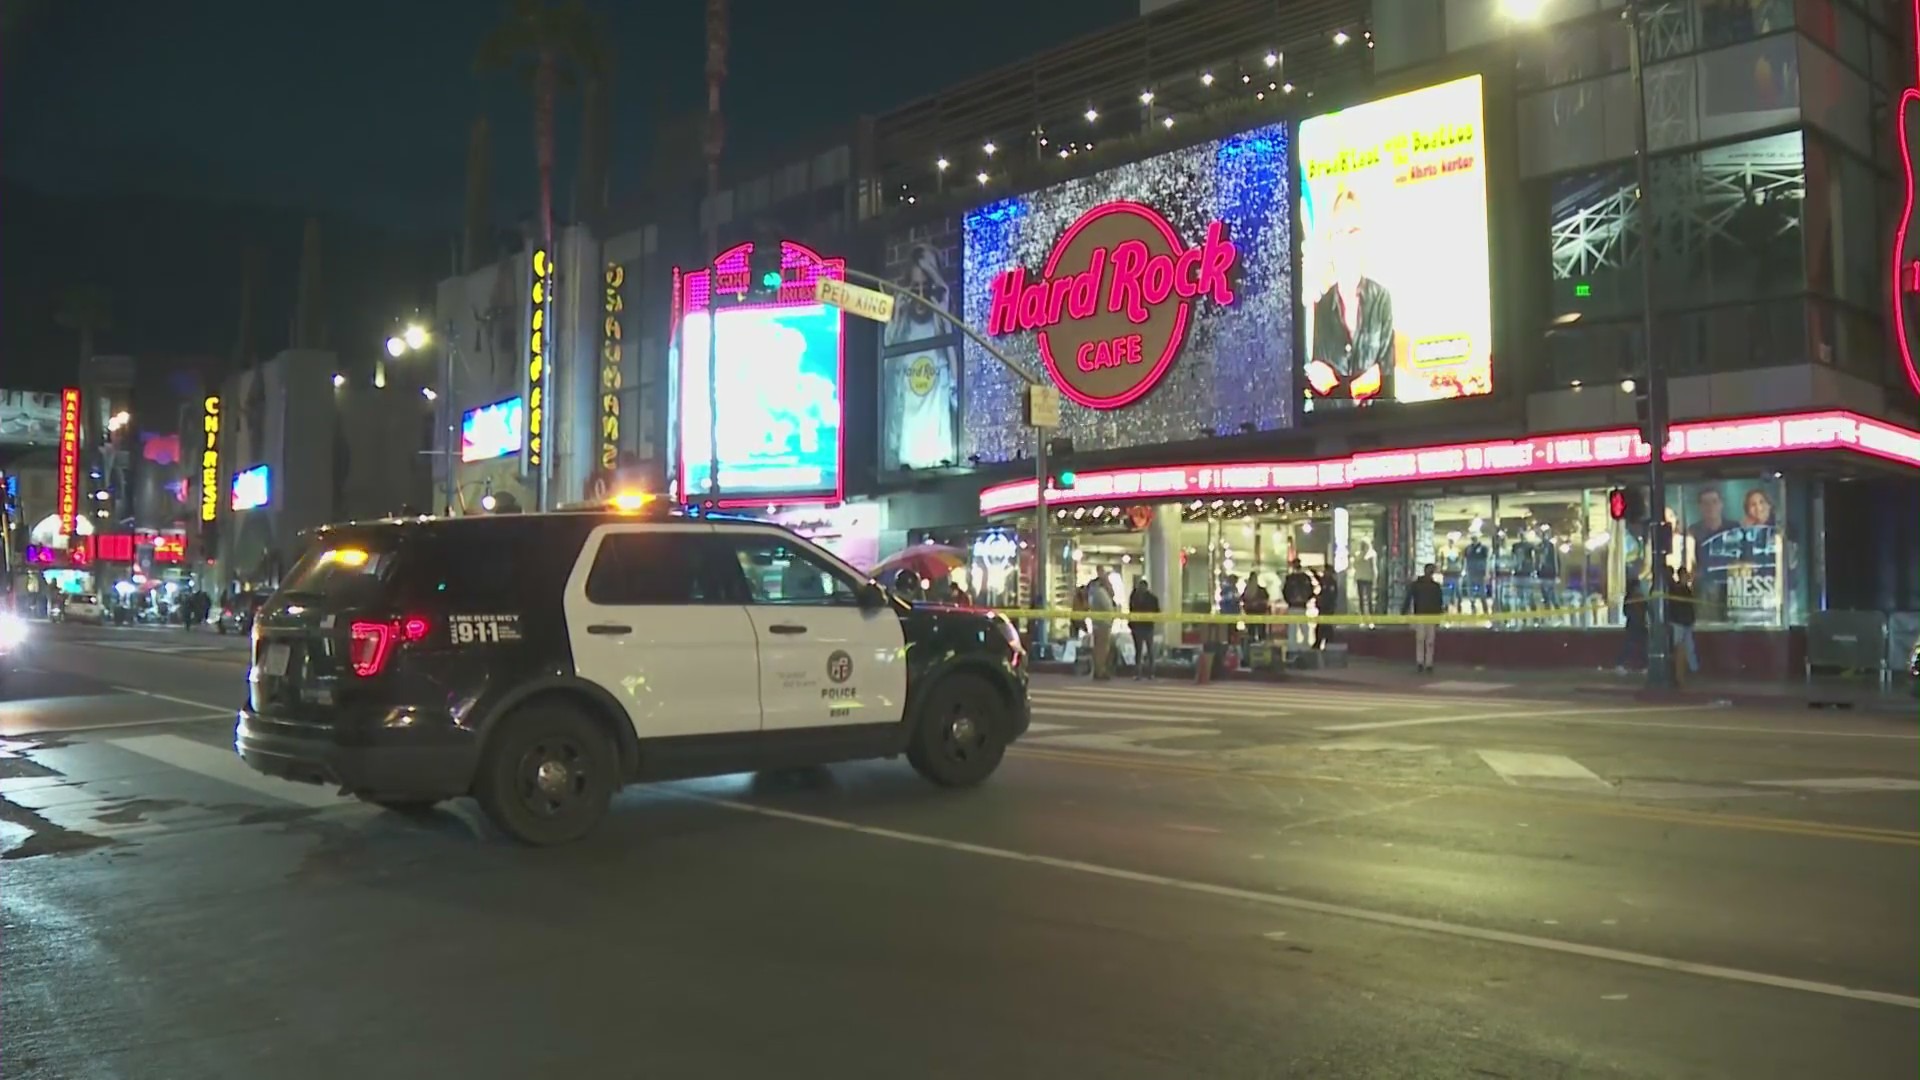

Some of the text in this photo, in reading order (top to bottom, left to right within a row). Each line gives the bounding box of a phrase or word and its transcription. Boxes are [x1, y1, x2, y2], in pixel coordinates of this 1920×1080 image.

[822, 283, 849, 304] PED
[988, 219, 1237, 336] Hard Rock
[1076, 334, 1143, 373] CAFE
[61, 391, 77, 533] MADAME TUSSAUDS
[202, 396, 220, 521] CHINESE
[1727, 576, 1775, 596] MESS
[821, 687, 856, 699] POLICE
